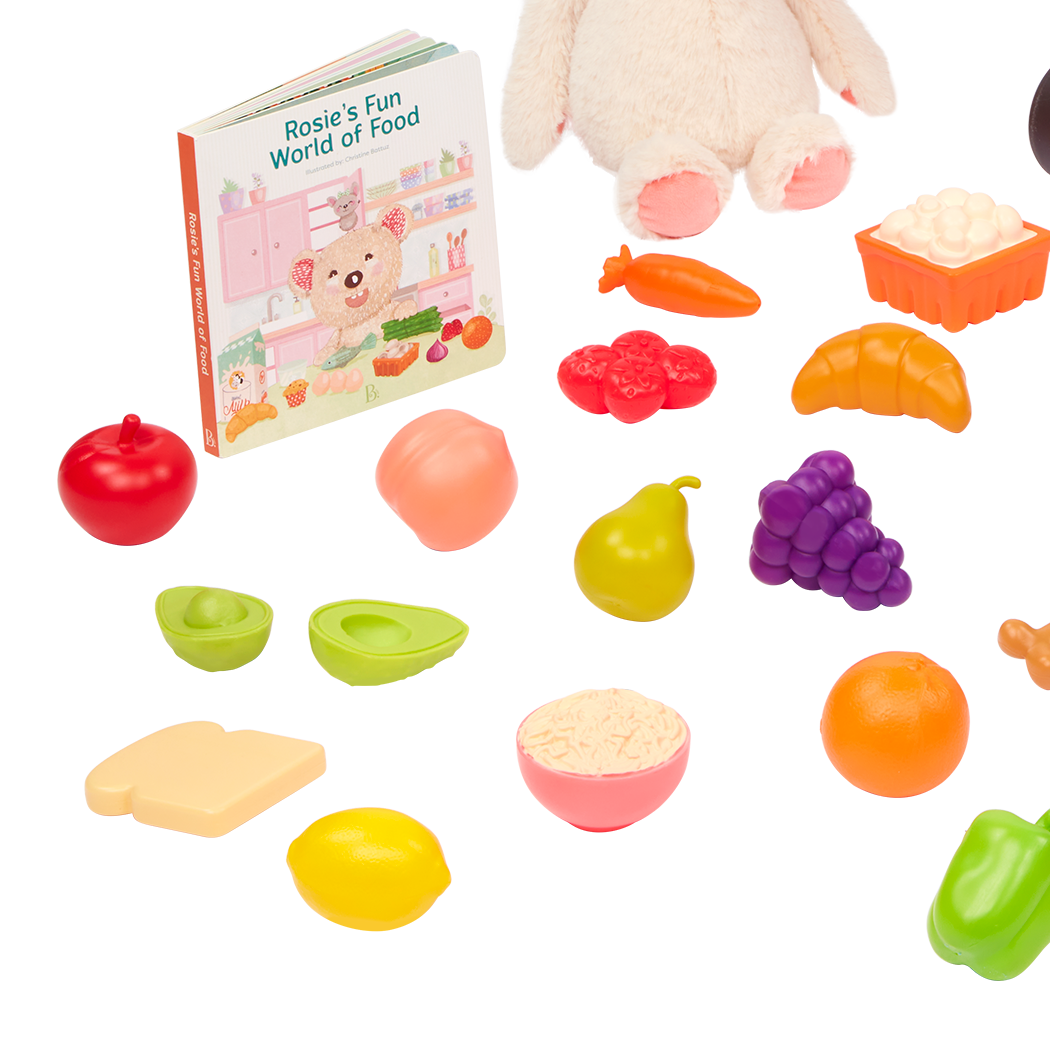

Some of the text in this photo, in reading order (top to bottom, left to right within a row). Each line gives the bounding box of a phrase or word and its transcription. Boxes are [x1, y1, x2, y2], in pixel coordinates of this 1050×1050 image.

[269, 105, 420, 169] World of Food
[285, 92, 402, 141] Rosie's Fun
[305, 162, 335, 175] Illustrated
[345, 150, 370, 163] Christine
[189, 212, 209, 376] Rosie's Fun World of Food
